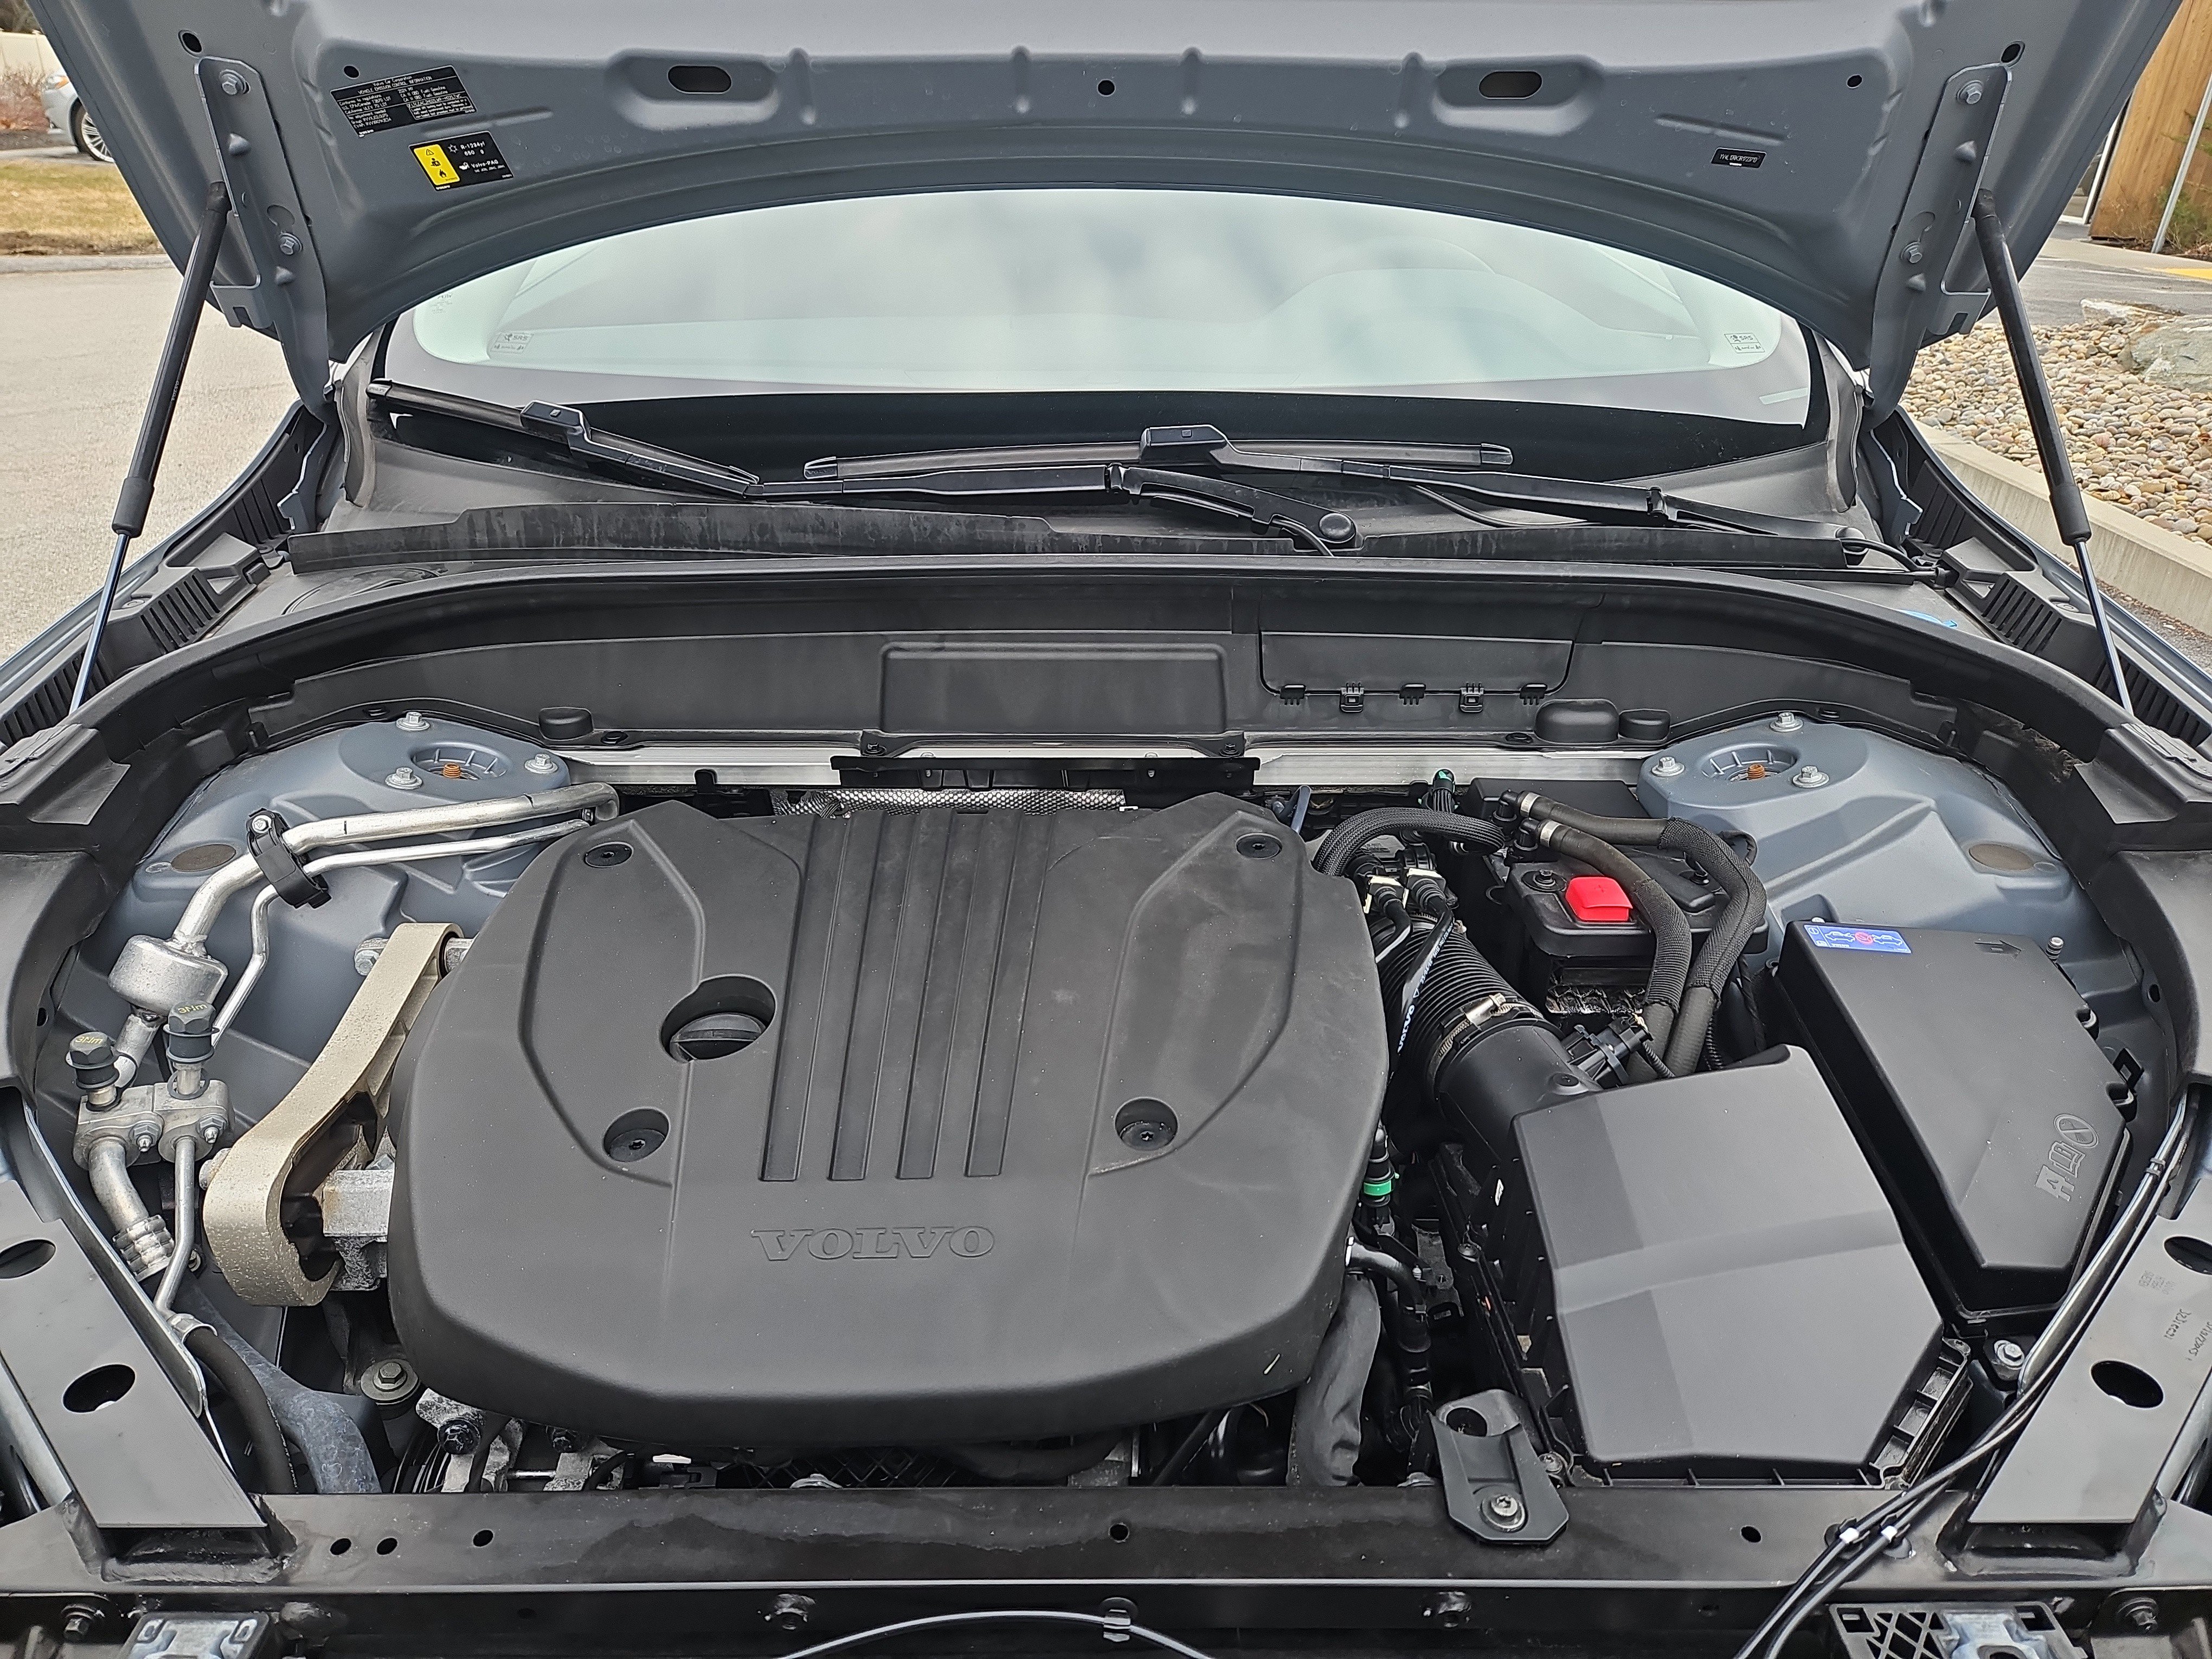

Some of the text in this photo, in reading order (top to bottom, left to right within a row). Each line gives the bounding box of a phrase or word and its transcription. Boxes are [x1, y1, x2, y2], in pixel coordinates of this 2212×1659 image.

[177, 1003, 208, 1014] 3Nm
[75, 1036, 103, 1044] 3Nm
[1397, 1005, 1415, 1053] VOLVO
[751, 1226, 994, 1261] VOLVO
